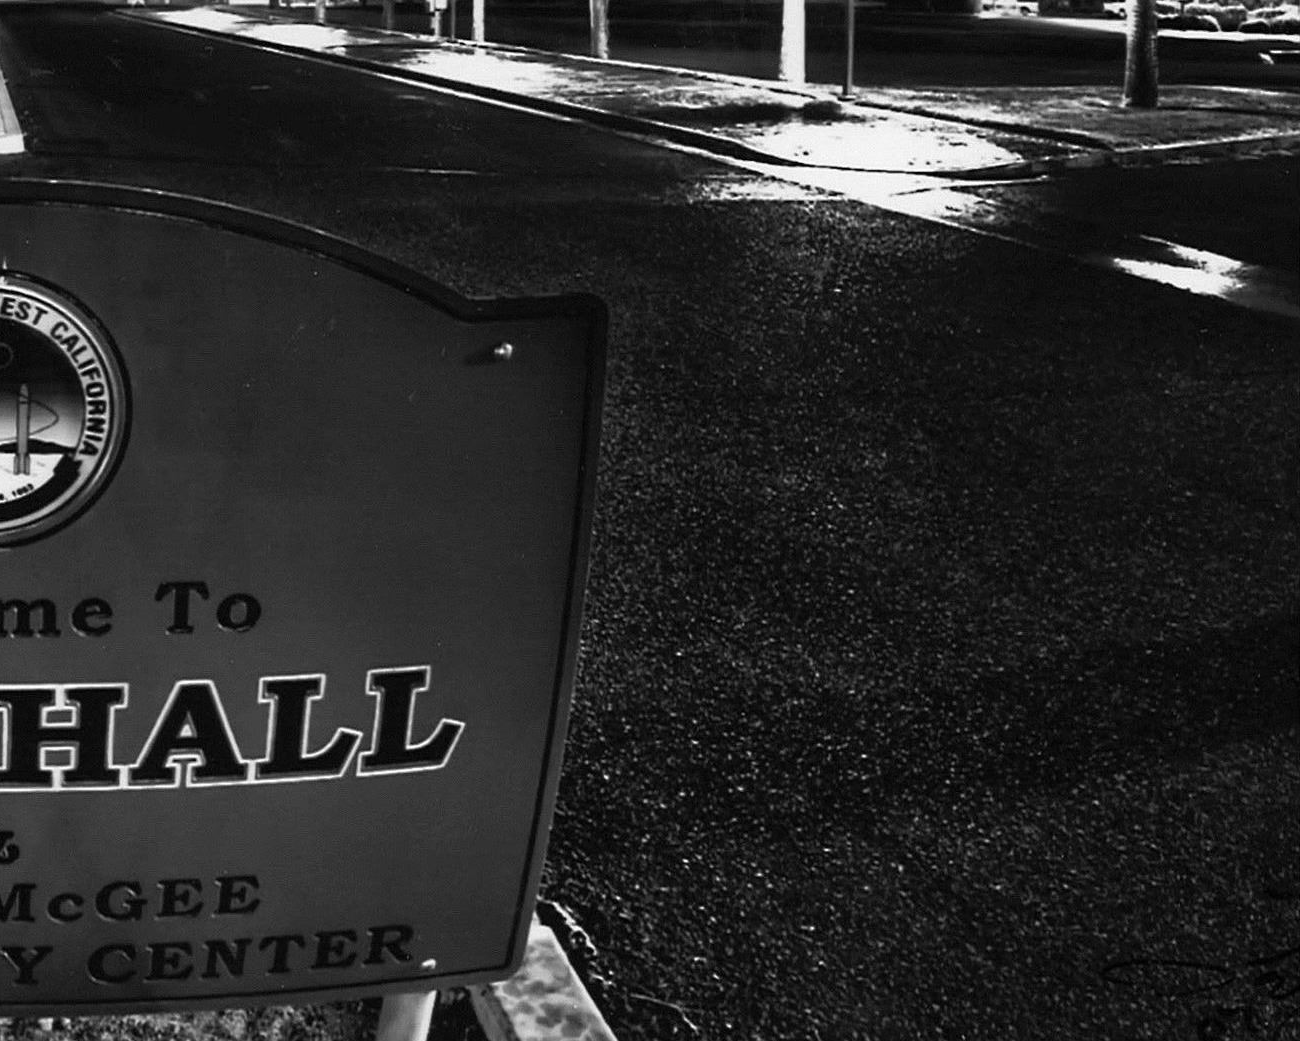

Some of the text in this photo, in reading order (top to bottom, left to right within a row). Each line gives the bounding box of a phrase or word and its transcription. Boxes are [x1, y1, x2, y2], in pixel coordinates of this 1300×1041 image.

[49, 321, 107, 457] CALIFORNIA
[154, 580, 263, 635] To
[85, 923, 416, 986] CENTER
